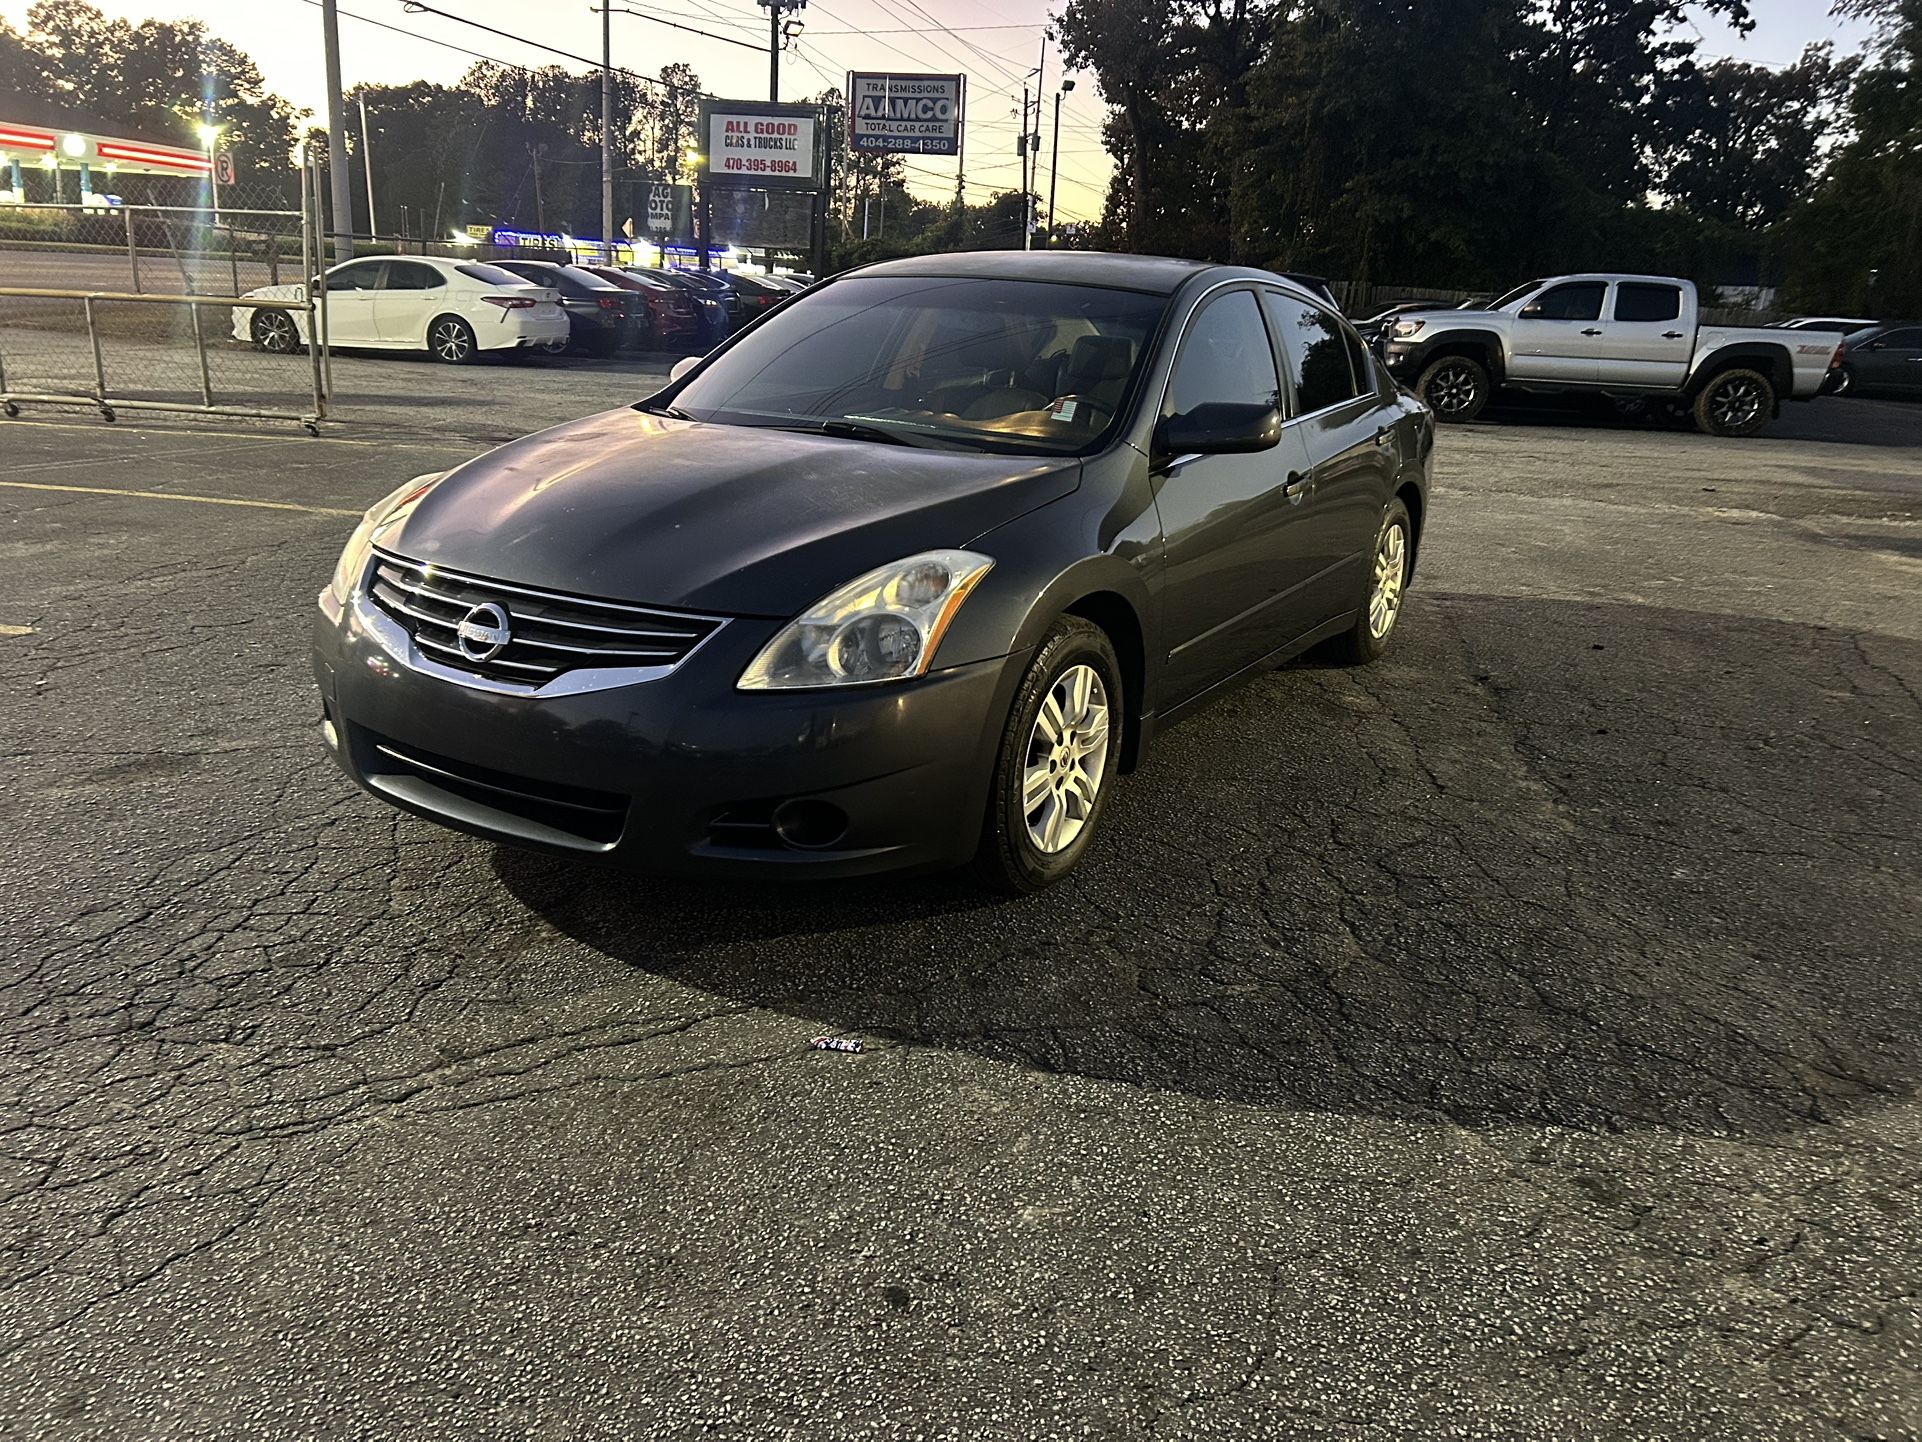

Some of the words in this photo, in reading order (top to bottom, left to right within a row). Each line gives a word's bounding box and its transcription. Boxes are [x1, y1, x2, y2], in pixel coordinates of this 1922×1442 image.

[866, 82, 945, 94] TRANSMISSIONS
[859, 97, 949, 120] AAMCO
[725, 120, 750, 134] ALL
[754, 121, 798, 136] GOOD
[865, 122, 894, 132] TOTAL
[896, 124, 916, 133] CAR
[918, 125, 944, 133] CARE
[746, 138, 752, 148] &
[753, 136, 784, 150] TRUCKS
[725, 157, 798, 174] 470-395-8964
